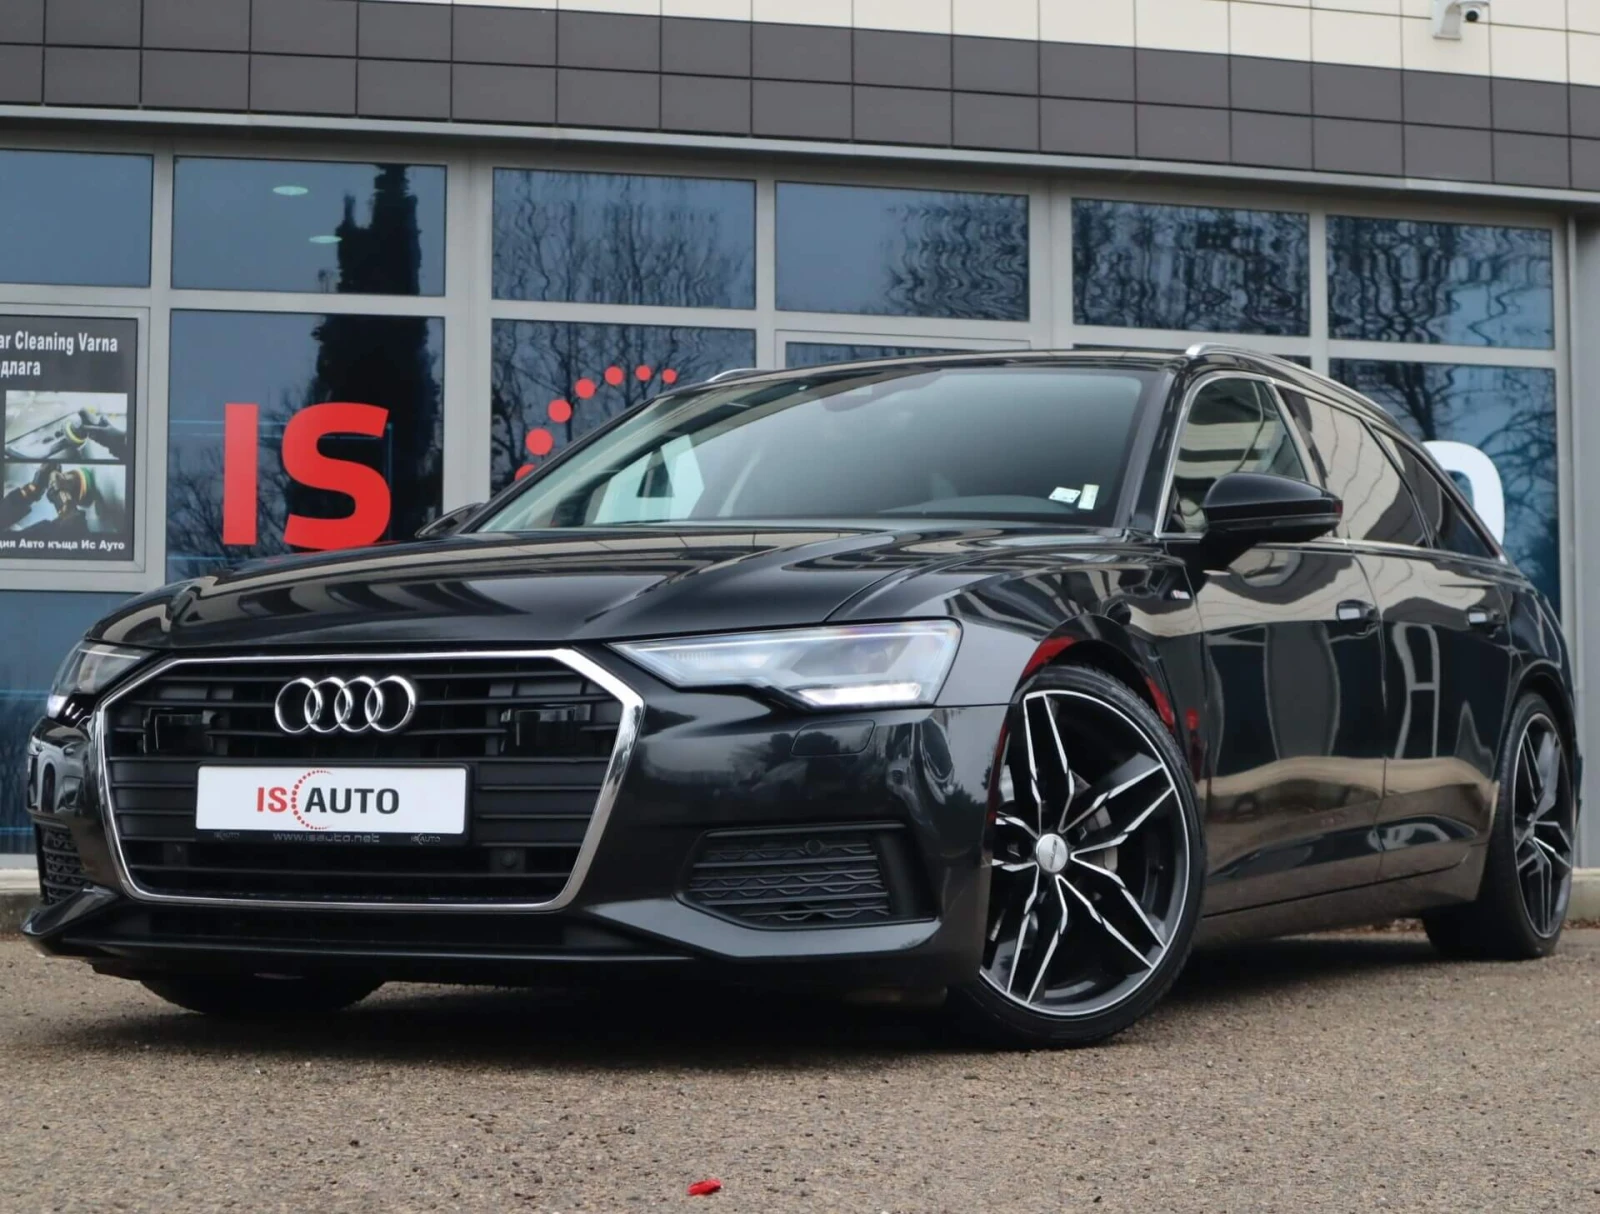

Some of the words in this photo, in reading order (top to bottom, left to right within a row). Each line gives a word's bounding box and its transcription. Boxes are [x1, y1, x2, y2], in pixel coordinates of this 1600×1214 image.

[15, 330, 74, 356] Cleaning
[78, 332, 118, 352] Varna
[0, 360, 41, 378] длага
[223, 402, 391, 551] IS
[19, 538, 45, 549] Авто
[47, 540, 78, 551] къща
[81, 539, 96, 549] Ис
[99, 540, 125, 552] Ауто
[257, 787, 288, 812] IS
[304, 787, 399, 814] AUTO
